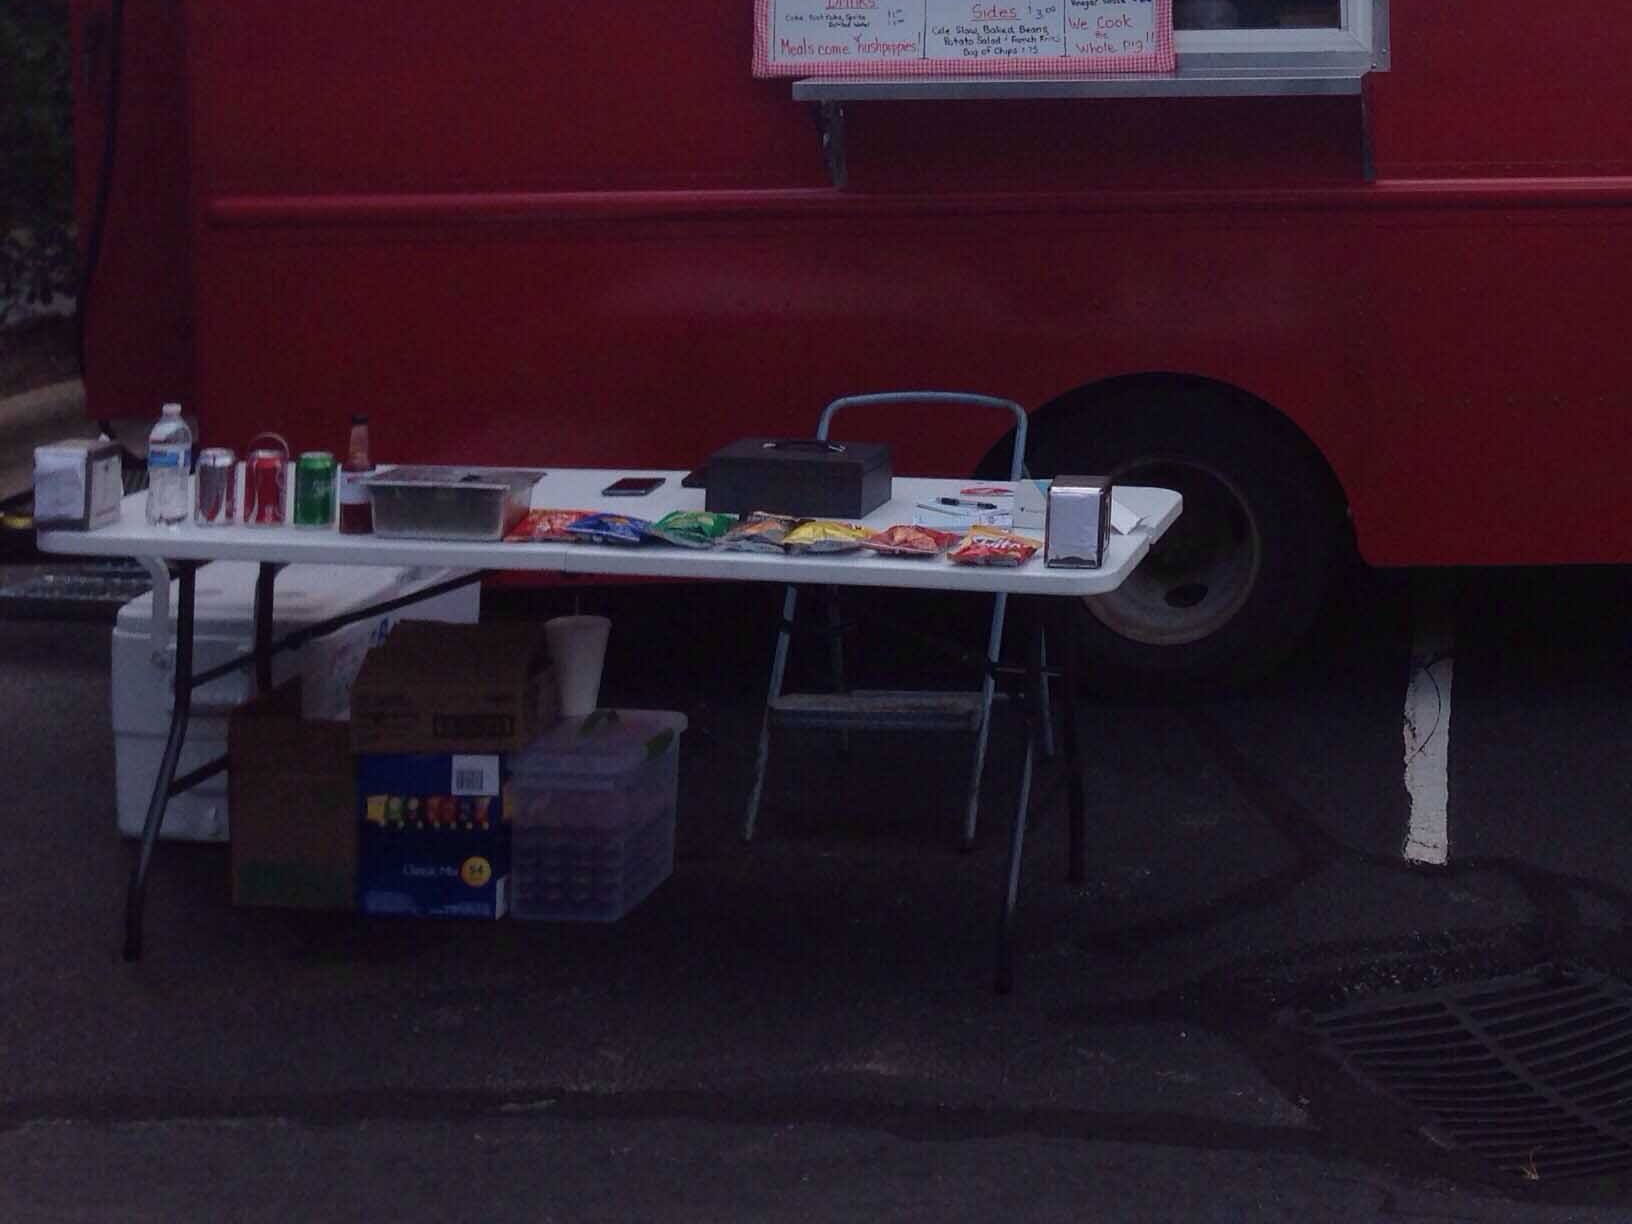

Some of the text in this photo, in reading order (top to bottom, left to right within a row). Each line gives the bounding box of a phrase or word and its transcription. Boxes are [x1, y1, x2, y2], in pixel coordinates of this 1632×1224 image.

[972, 2, 1020, 22] Sides
[1068, 13, 1134, 30] We Cook
[780, 37, 816, 56] Meals
[817, 42, 850, 56] come
